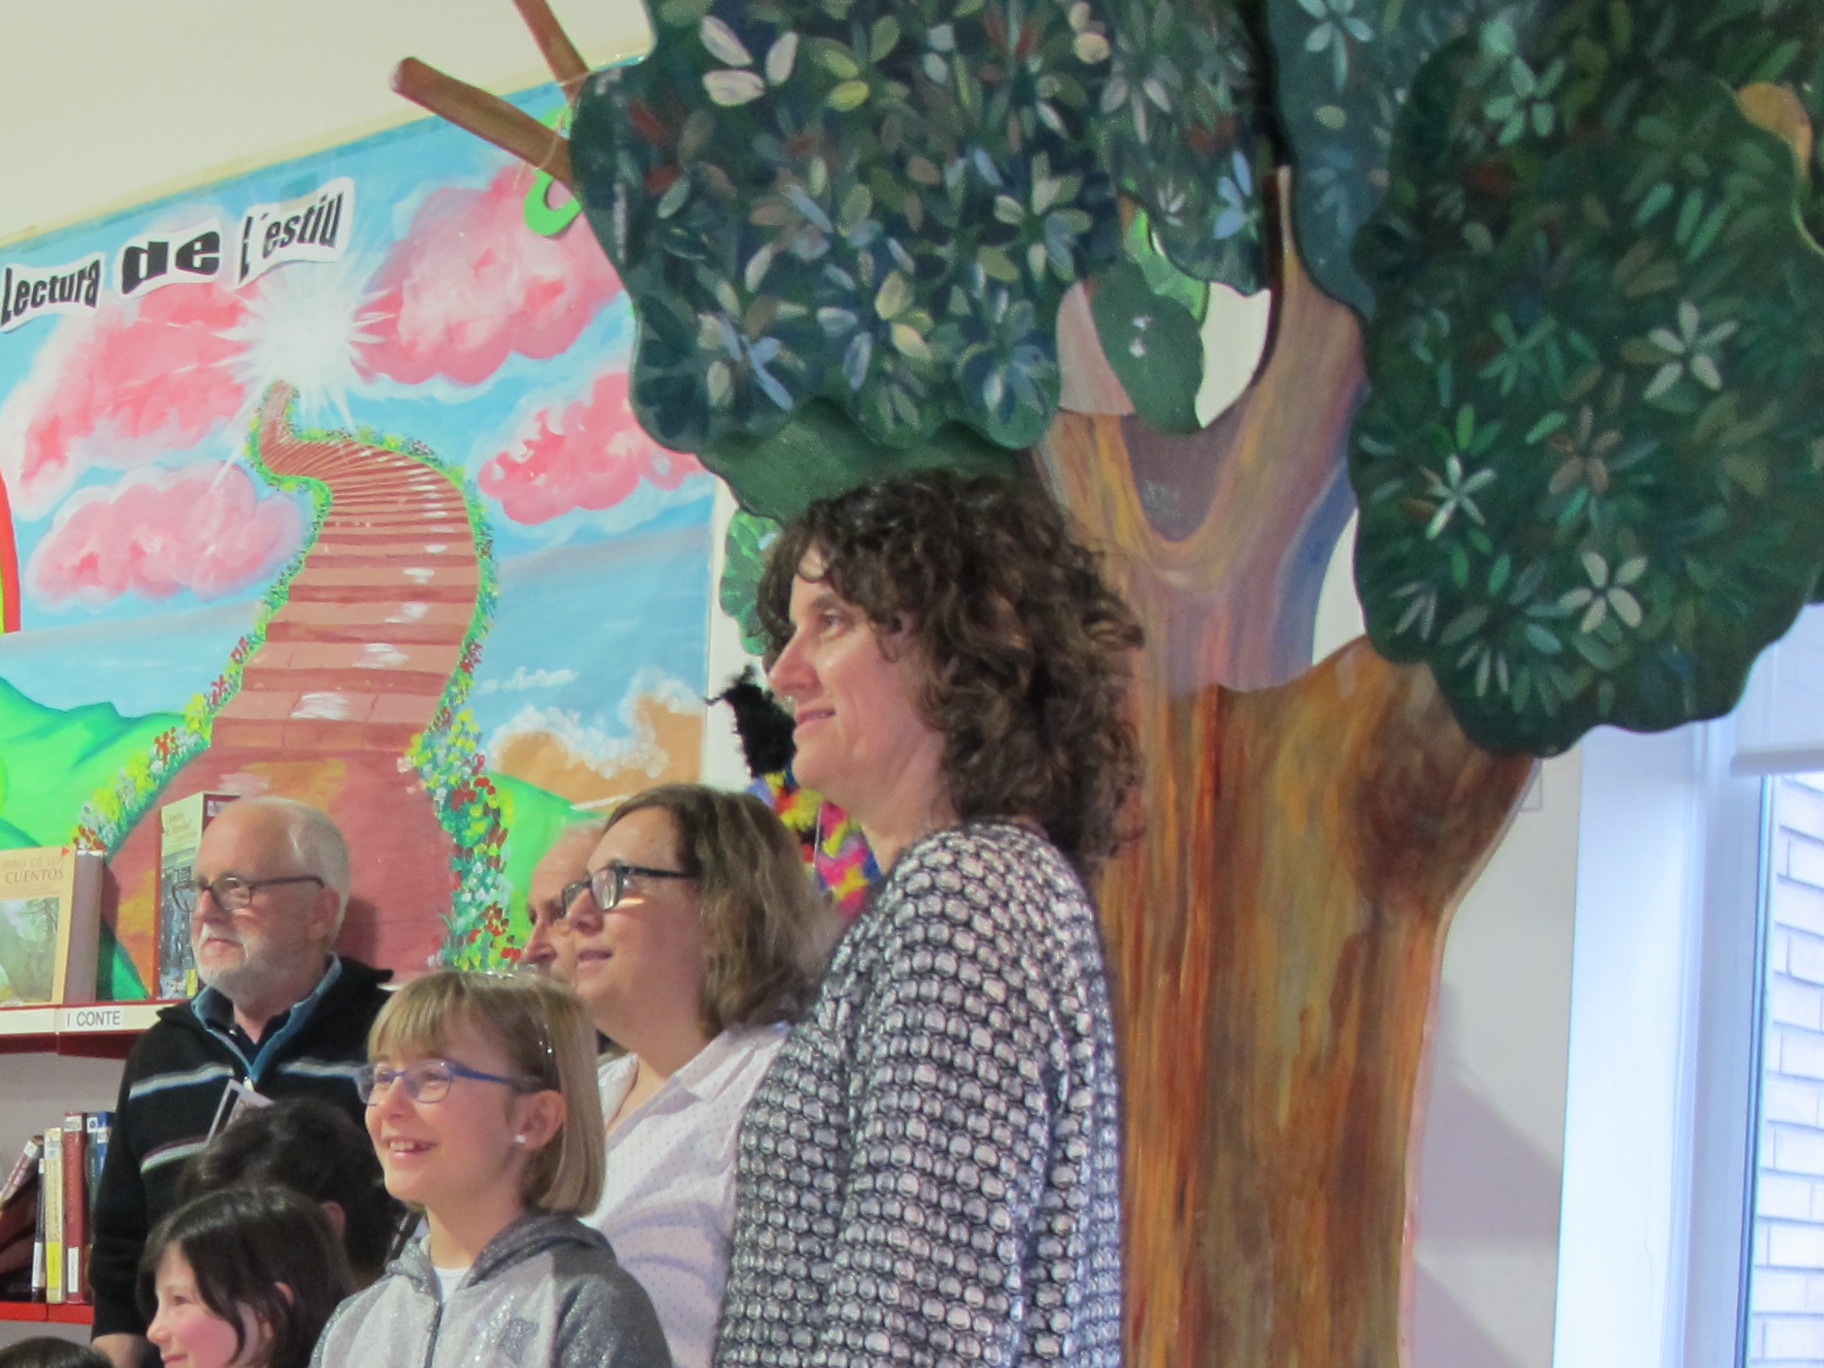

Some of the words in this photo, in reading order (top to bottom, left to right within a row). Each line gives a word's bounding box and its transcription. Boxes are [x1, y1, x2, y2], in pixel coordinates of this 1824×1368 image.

[121, 229, 221, 295] de
[5, 868, 65, 884] CUENTOS
[76, 1010, 122, 1027] CONTE
